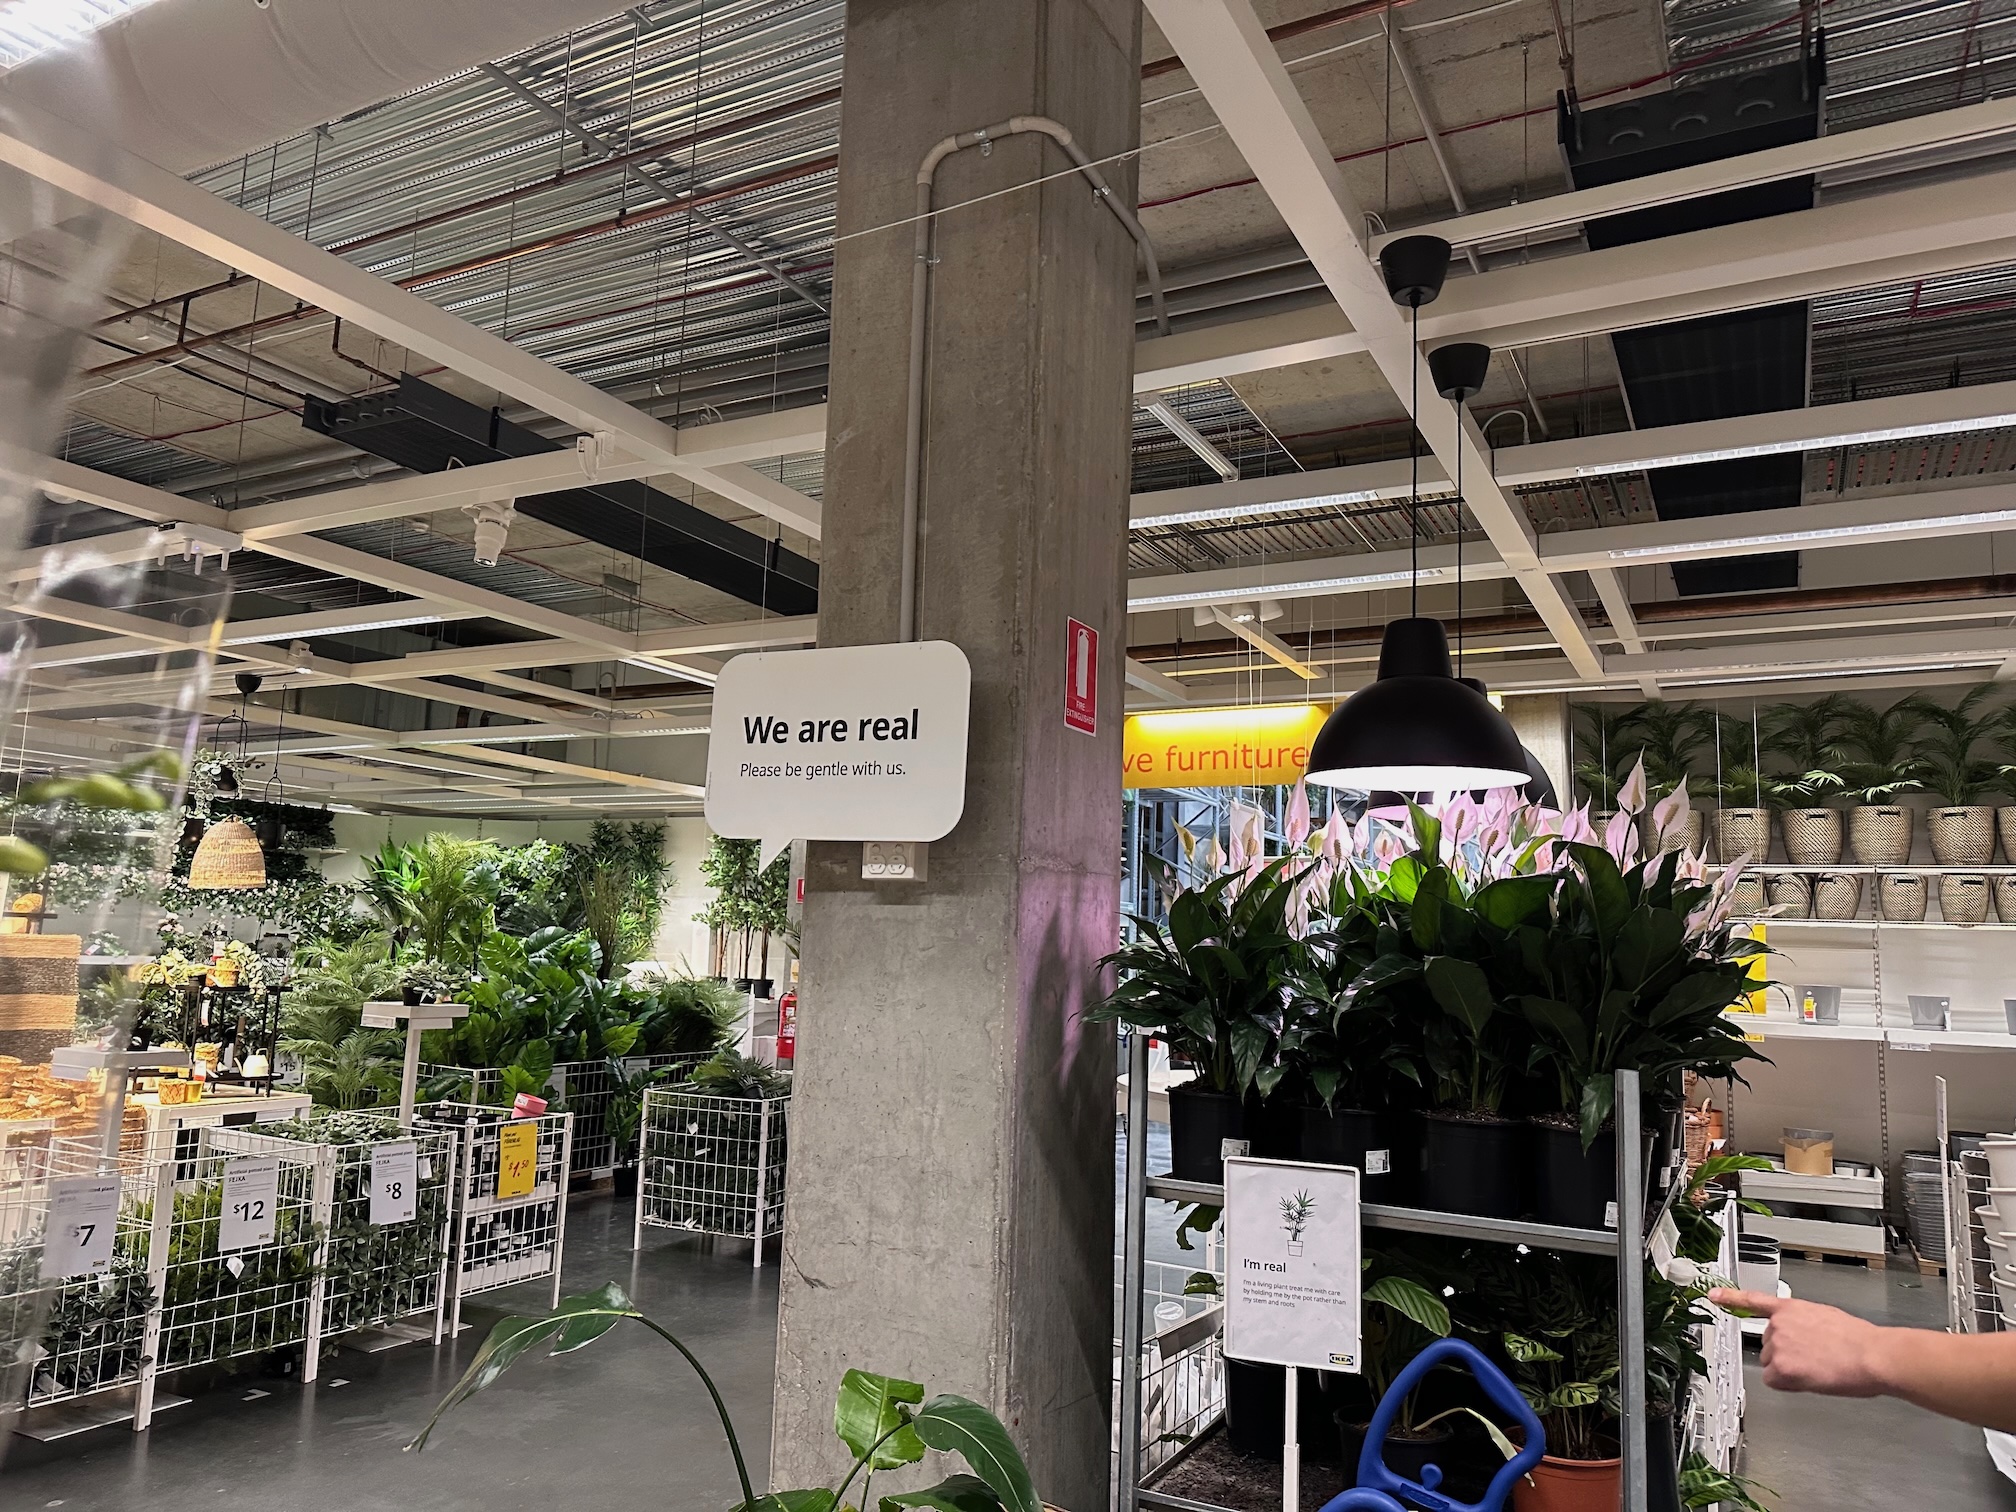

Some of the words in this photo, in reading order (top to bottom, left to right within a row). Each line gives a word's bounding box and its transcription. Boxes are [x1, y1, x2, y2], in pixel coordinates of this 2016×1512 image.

[1076, 700, 1086, 711] FIRE
[1066, 708, 1095, 725] EXTINGUISHER
[744, 715, 789, 744] We
[798, 717, 848, 743] are
[858, 708, 919, 742] real
[1165, 743, 1310, 772] furniture
[740, 762, 781, 777] Please
[785, 762, 802, 777] be
[806, 761, 848, 780] gentle
[852, 761, 882, 776] with
[886, 762, 906, 776] us.
[385, 1182, 402, 1200] $8
[233, 1200, 265, 1222] $12
[1264, 1262, 1286, 1273] real
[1257, 1281, 1272, 1289] living
[1251, 1289, 1272, 1298] holding
[1283, 1292, 1291, 1300] by
[1330, 1355, 1352, 1364] IKEA
